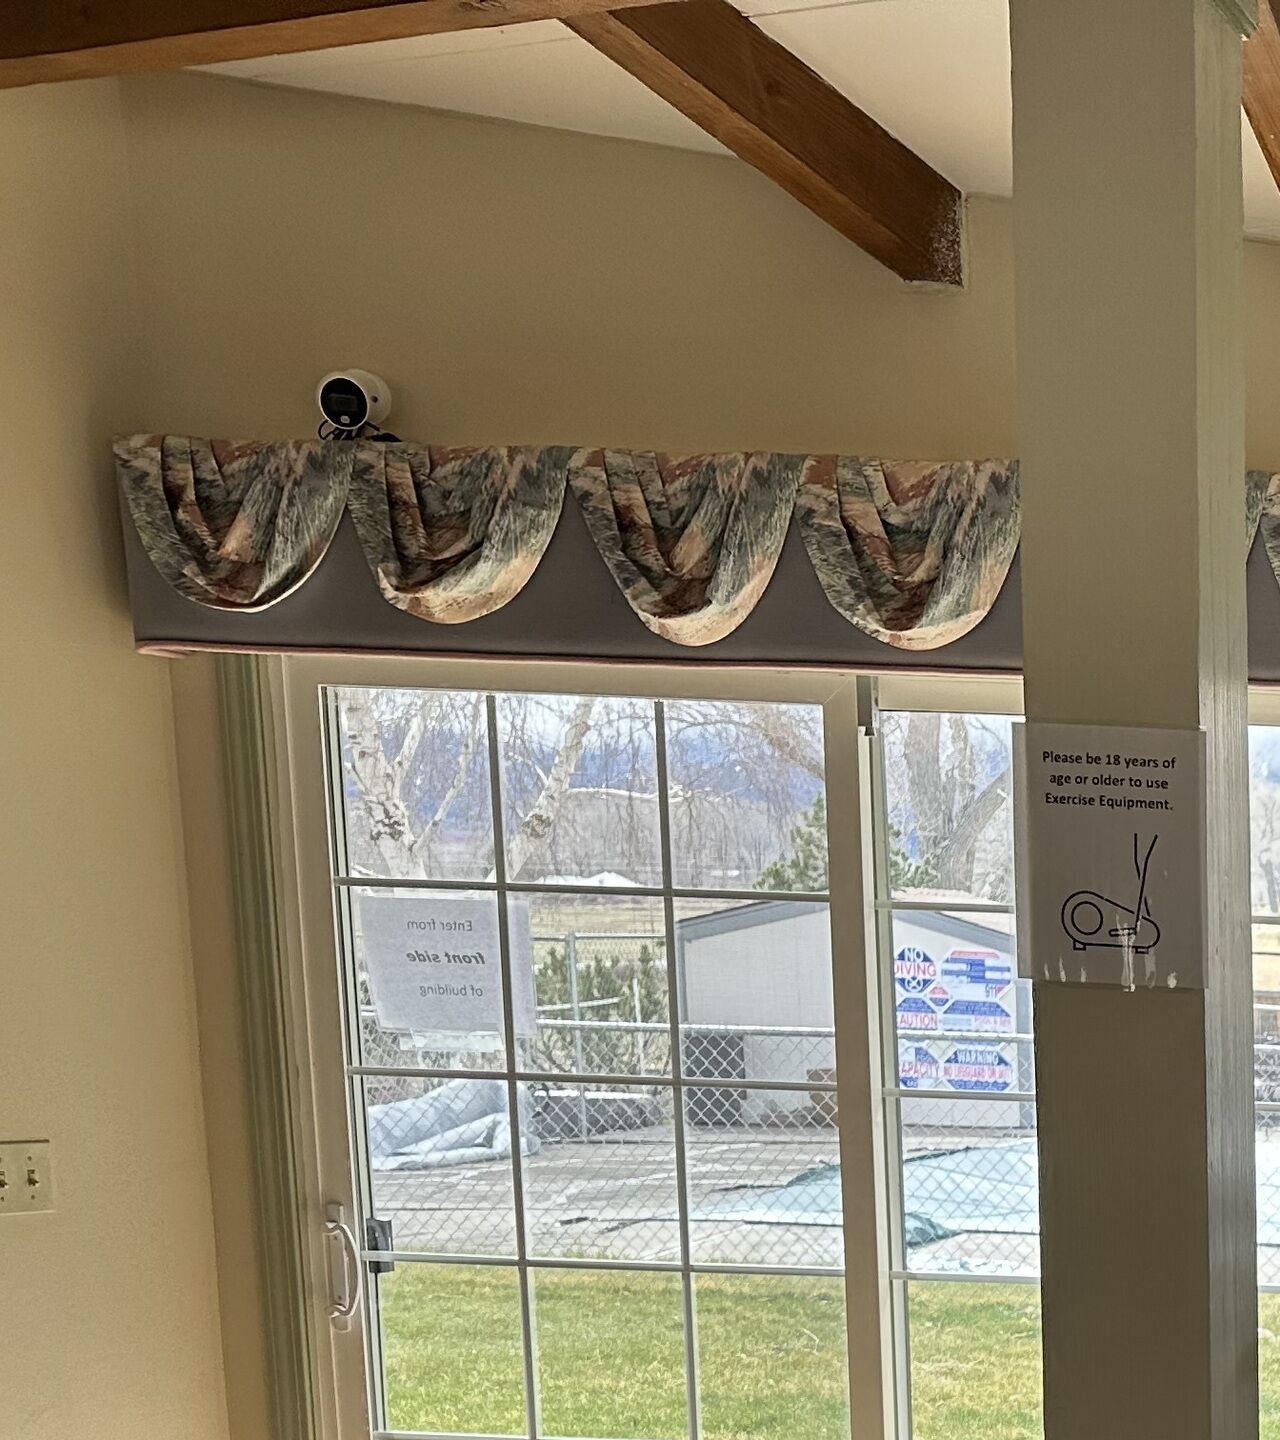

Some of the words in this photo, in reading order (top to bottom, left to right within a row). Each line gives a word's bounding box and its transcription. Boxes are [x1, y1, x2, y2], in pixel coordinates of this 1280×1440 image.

[1042, 751, 1082, 764] Please
[1086, 752, 1101, 765] be
[1106, 754, 1120, 766] 18
[1124, 757, 1159, 769] years
[1162, 757, 1176, 769] of
[1049, 774, 1071, 786] age
[1074, 775, 1088, 785] or
[1092, 774, 1125, 786] older
[1129, 776, 1142, 788] to
[1146, 779, 1169, 789] use
[1045, 792, 1095, 806] Exercise
[1099, 795, 1174, 810] Equipment.
[905, 947, 924, 962] NO
[899, 1014, 937, 1028] AUTION
[957, 1049, 999, 1065] WARNING
[901, 1062, 940, 1077] APACITY
